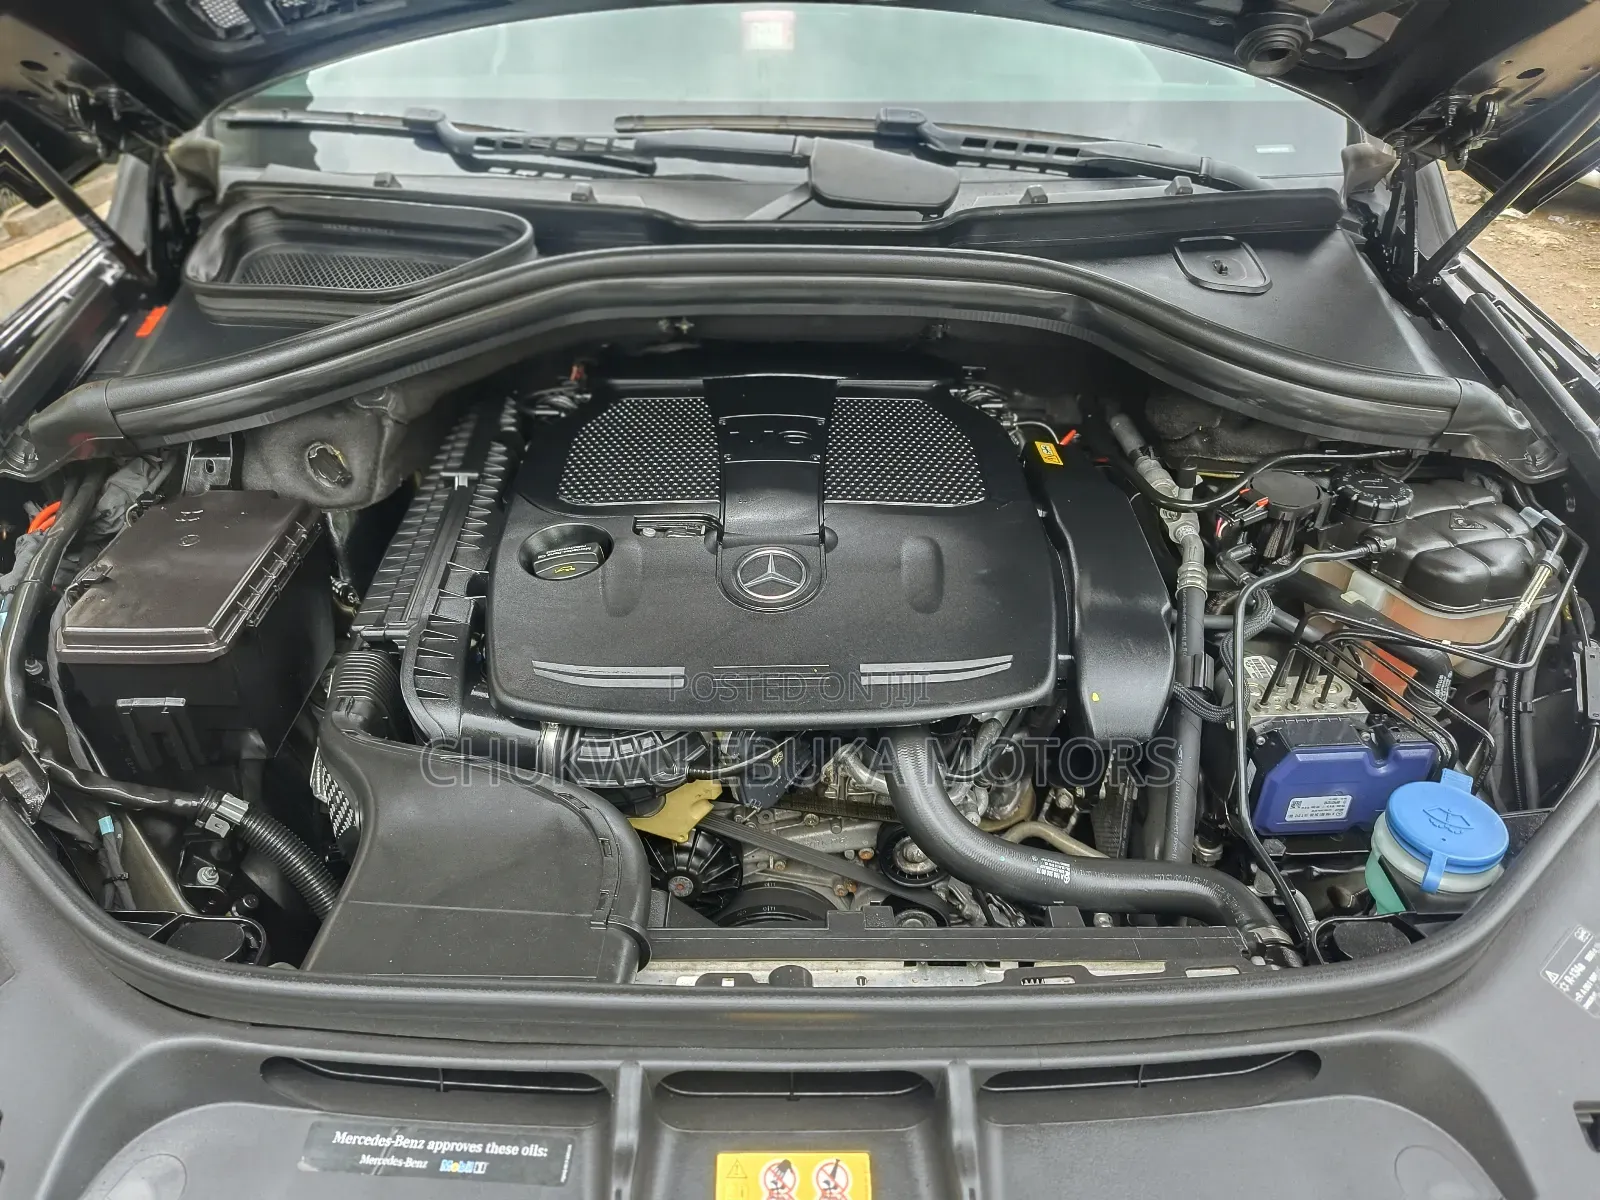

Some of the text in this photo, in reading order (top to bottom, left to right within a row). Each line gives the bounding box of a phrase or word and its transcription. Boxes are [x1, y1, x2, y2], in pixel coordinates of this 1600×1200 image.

[332, 1131, 548, 1158] Mercedes-Benz approves these oils:
[359, 1154, 428, 1169] Mercedes-Benz
[439, 1159, 475, 1174] Mobil
